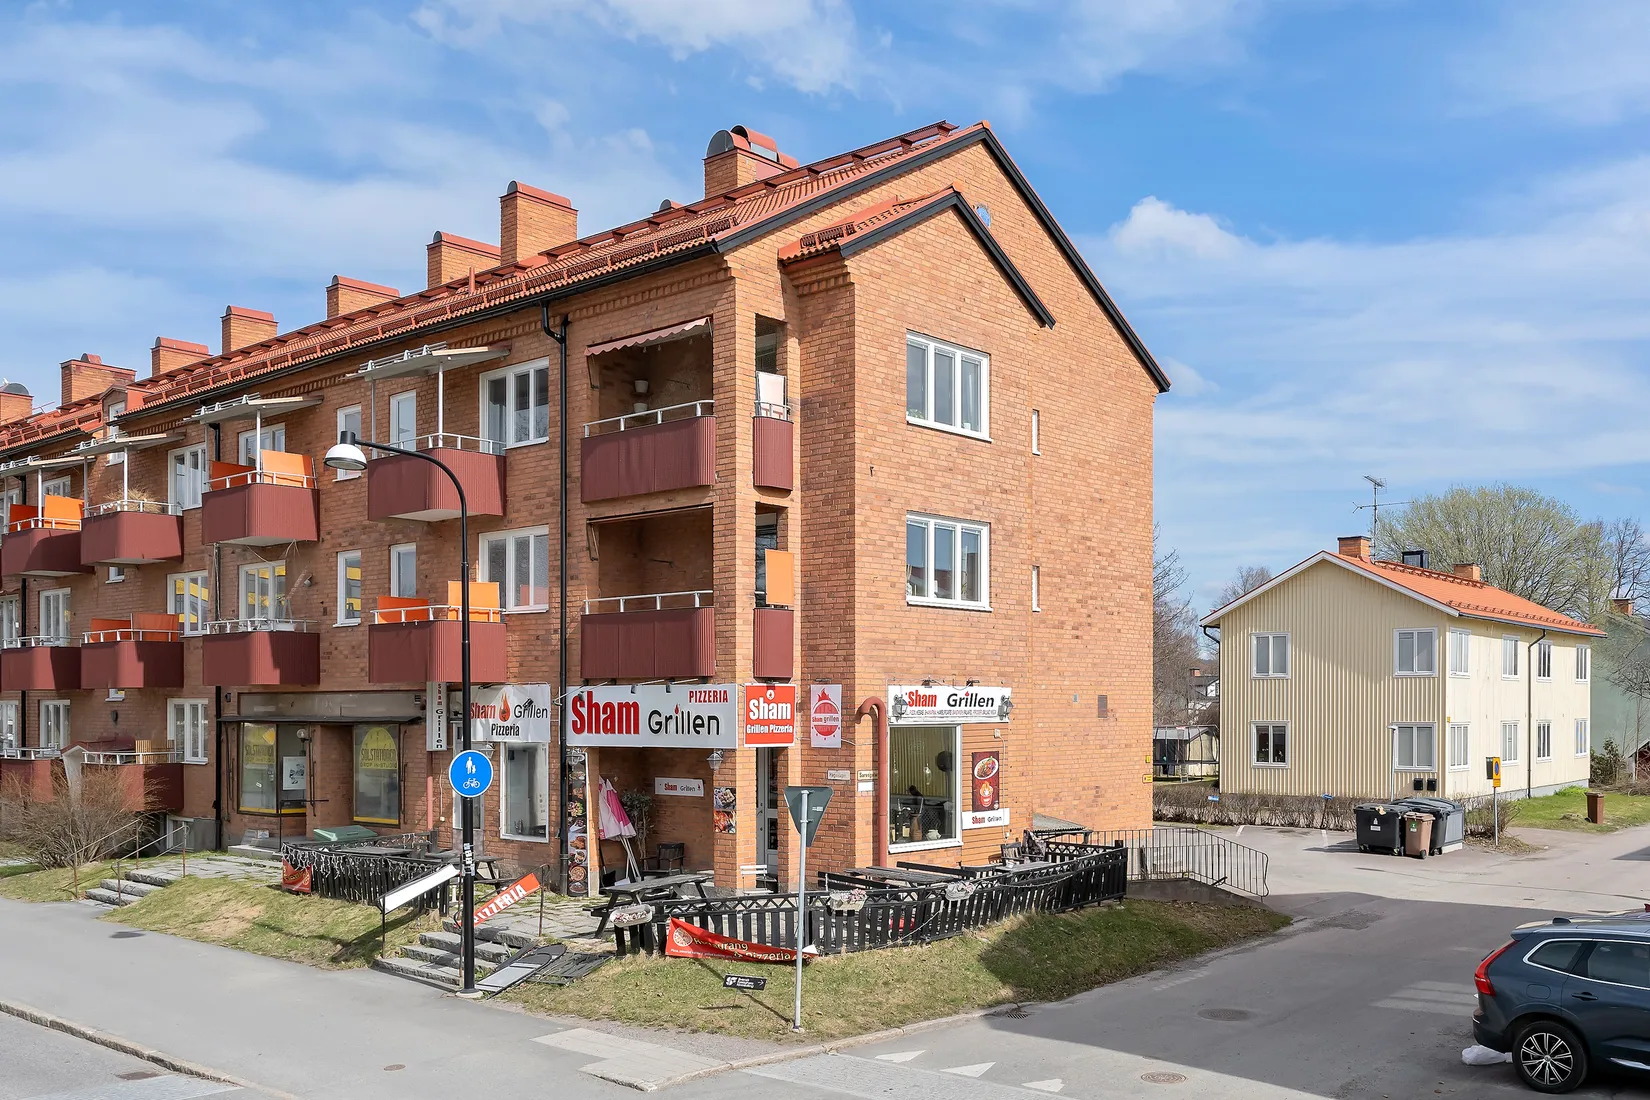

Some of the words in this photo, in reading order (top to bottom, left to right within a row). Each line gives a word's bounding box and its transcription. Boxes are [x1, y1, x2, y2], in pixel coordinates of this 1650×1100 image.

[689, 690, 729, 703] PIZZERIA
[908, 690, 937, 707] Sham
[947, 691, 995, 707] Grillen
[470, 702, 496, 719] Sham
[514, 703, 548, 719] Grillen
[571, 690, 640, 735] Sham
[648, 704, 720, 735] Grillen
[749, 697, 791, 720] Sham
[491, 723, 520, 736] Pizzeria
[746, 724, 768, 734] Grillen
[769, 724, 793, 733] Pizzeria
[664, 783, 677, 791] Sham
[972, 816, 986, 825] Sham
